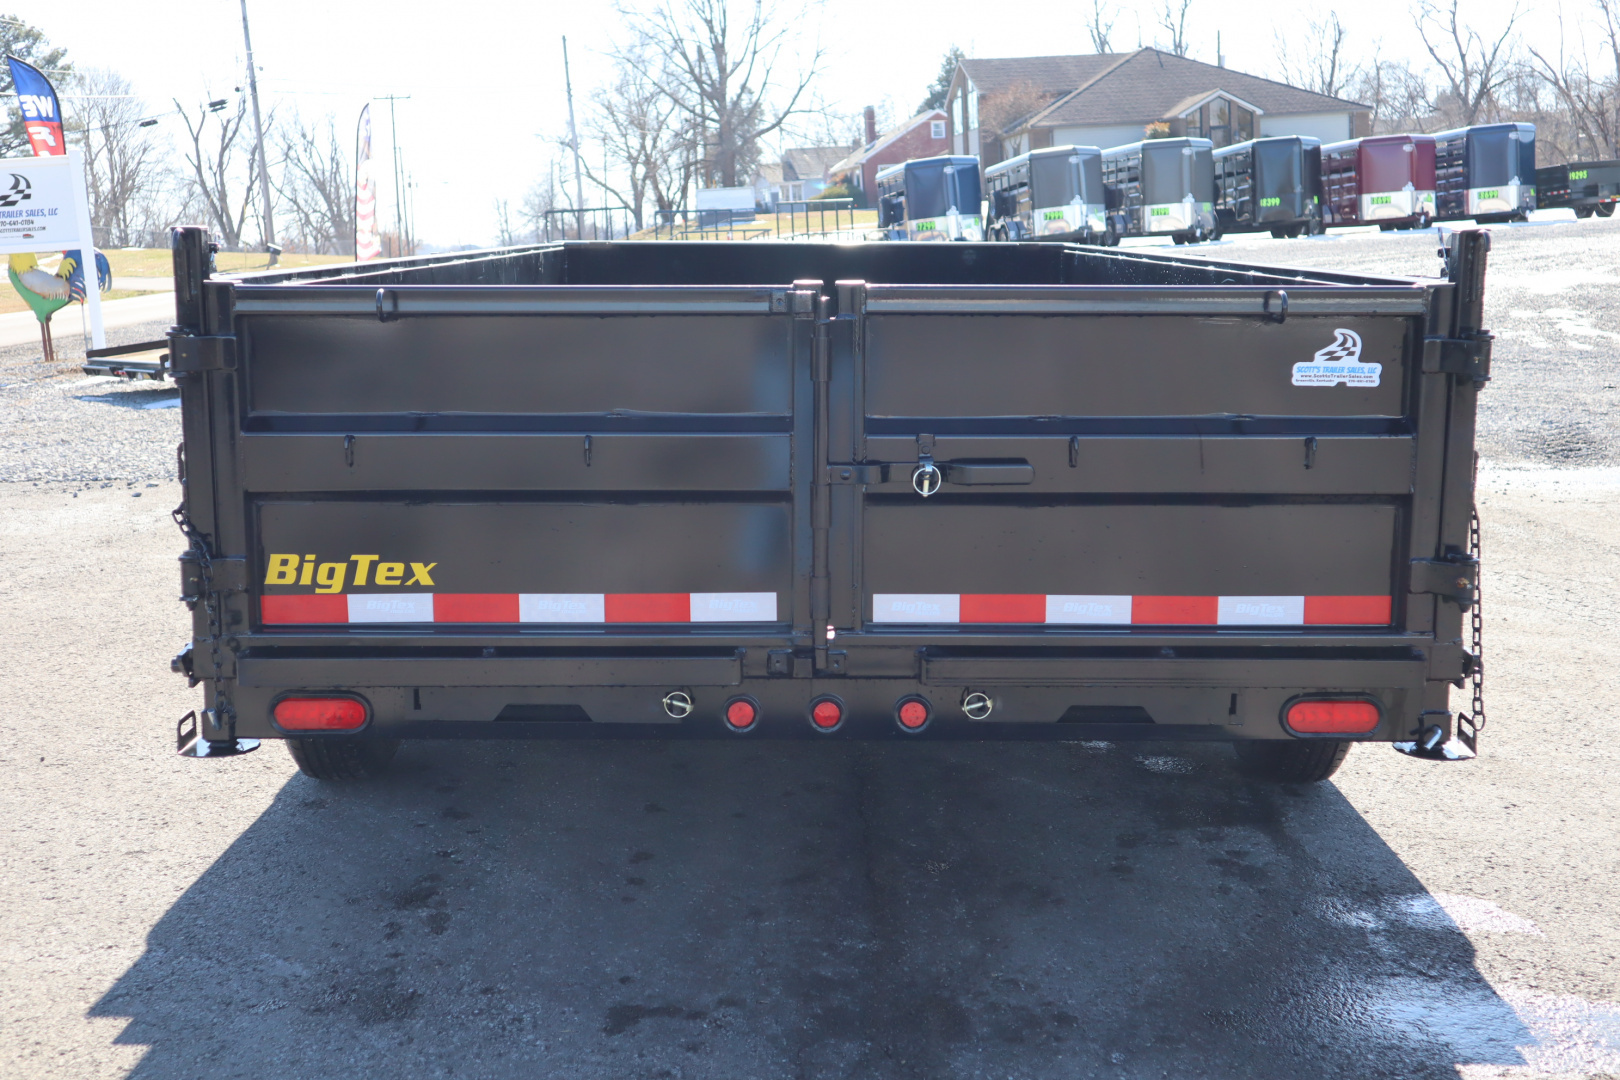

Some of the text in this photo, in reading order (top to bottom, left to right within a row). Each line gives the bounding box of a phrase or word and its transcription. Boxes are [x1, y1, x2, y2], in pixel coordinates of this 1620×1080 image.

[0, 207, 58, 219] TRAILER SALES, LLC
[1347, 366, 1366, 375] SALES,
